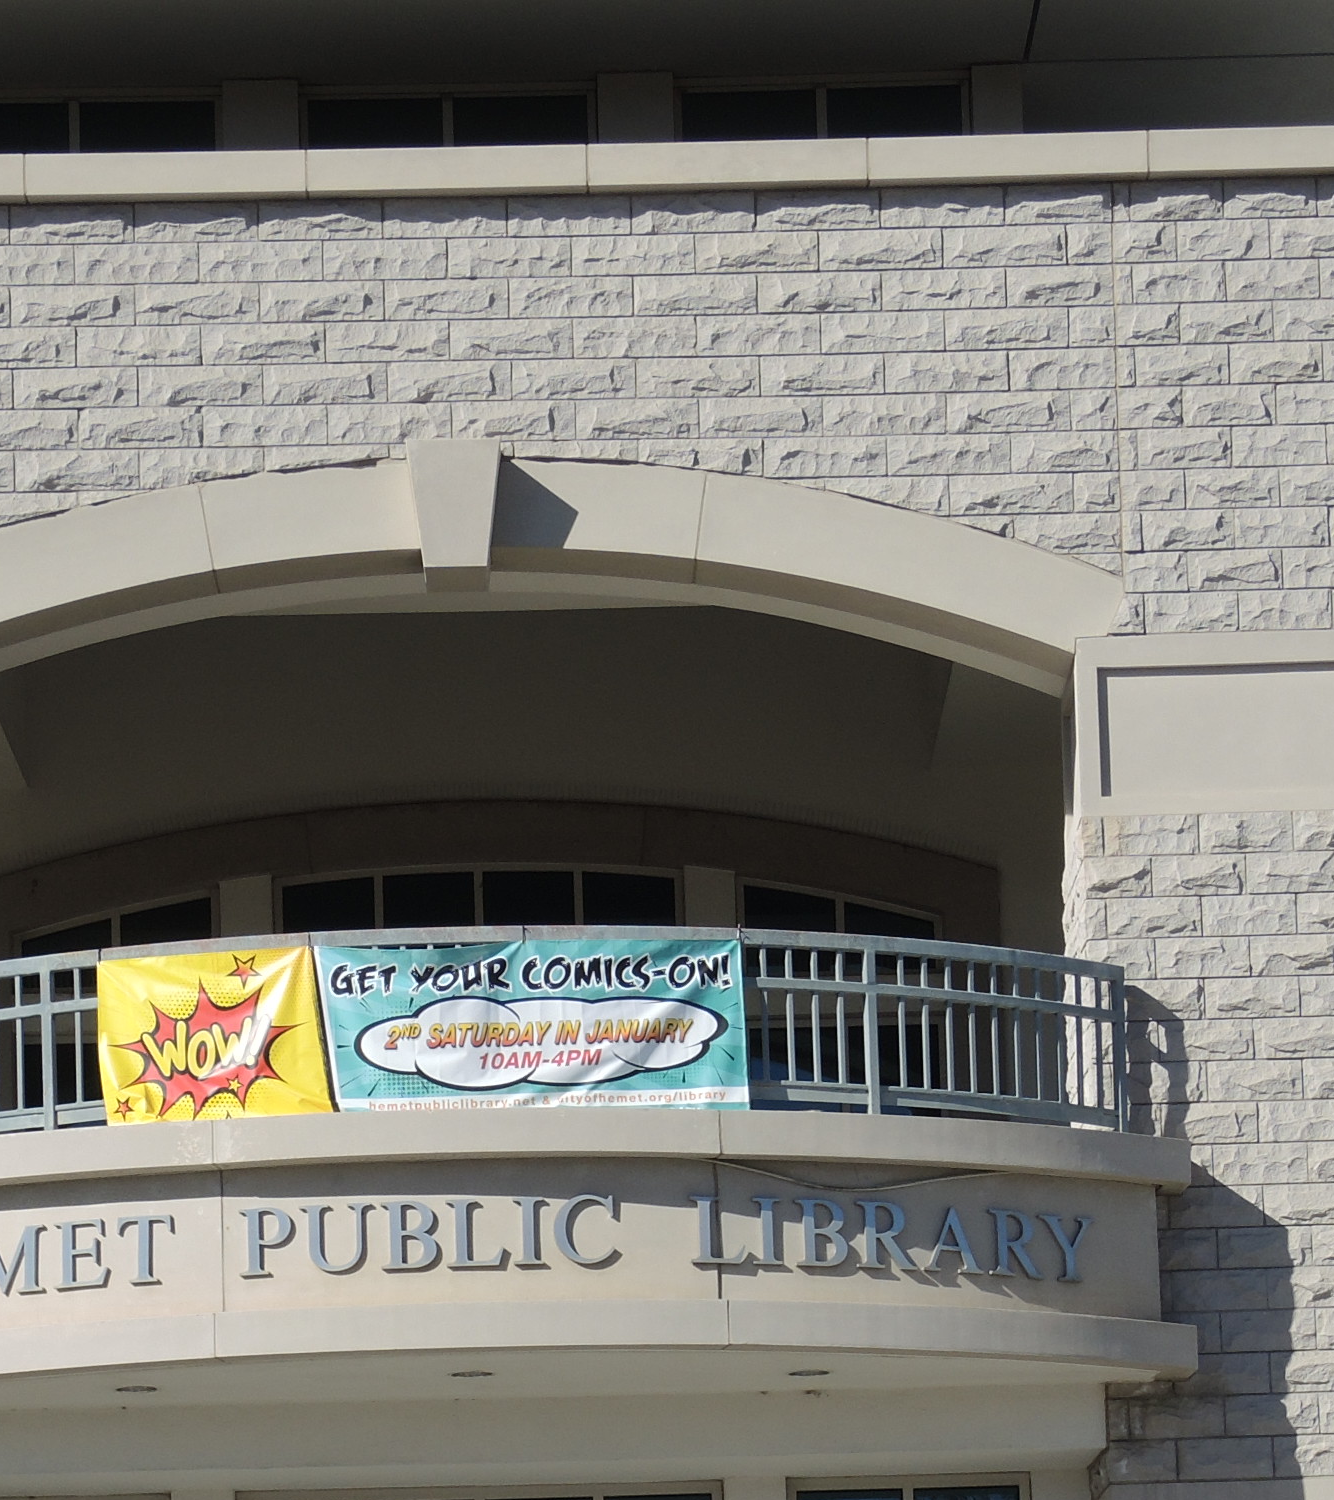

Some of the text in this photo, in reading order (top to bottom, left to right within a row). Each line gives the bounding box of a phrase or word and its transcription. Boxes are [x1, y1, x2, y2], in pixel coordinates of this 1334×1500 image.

[330, 953, 734, 997] GET YOUR COMICS-ON!
[141, 1014, 272, 1081] WOW!
[384, 1018, 694, 1050] 2ND SATURDAY IN JANUARY
[479, 1048, 603, 1071] 10AM-4PM
[543, 1095, 551, 1105] &
[238, 1193, 623, 1280] PUBLIC
[689, 1195, 1095, 1283] LIBRARY
